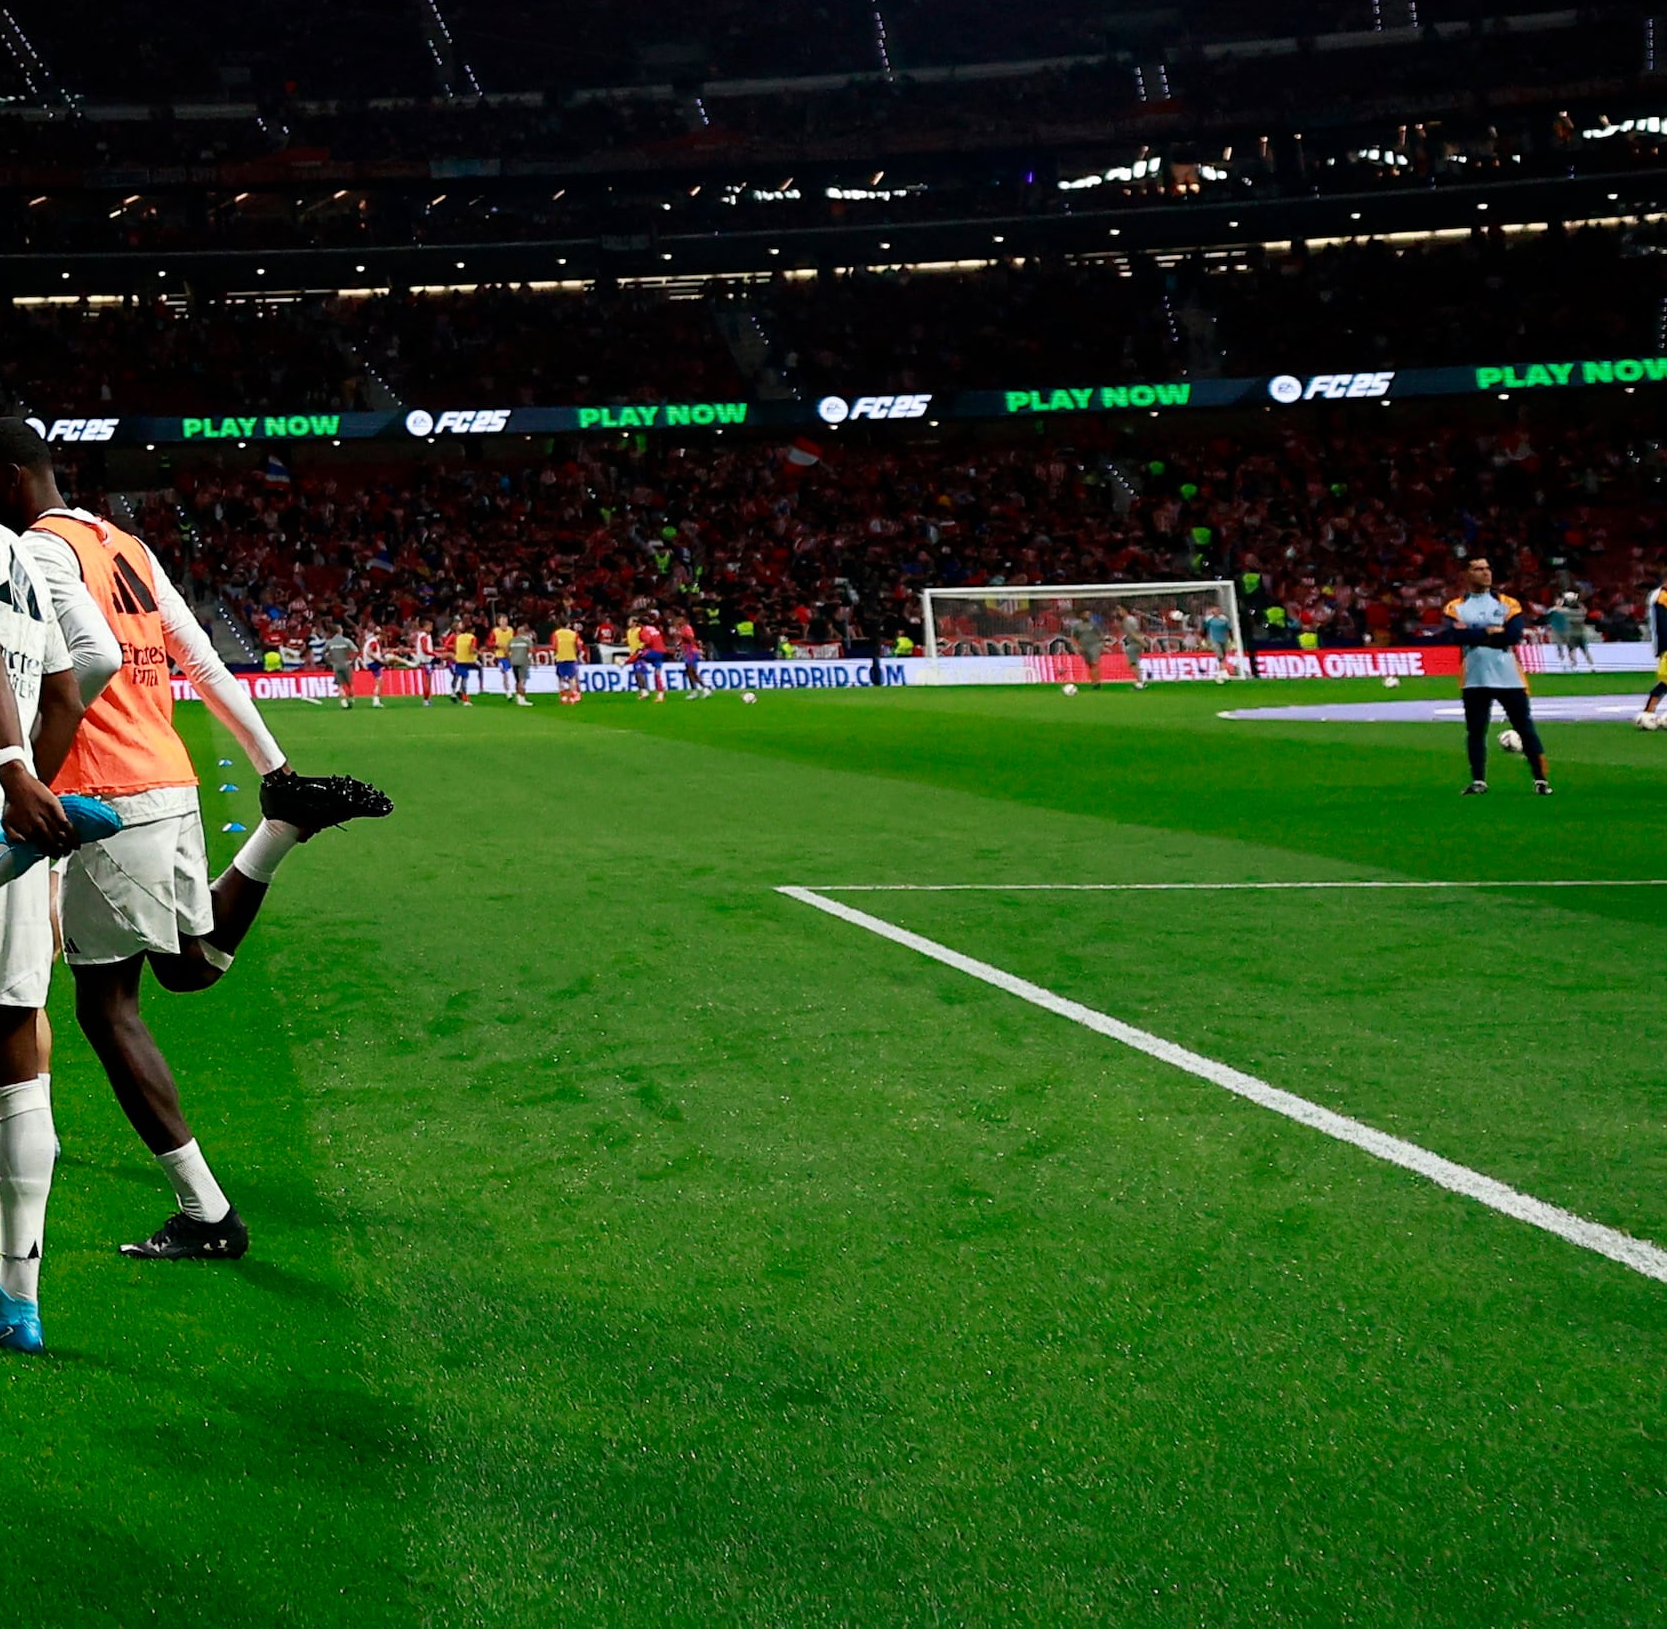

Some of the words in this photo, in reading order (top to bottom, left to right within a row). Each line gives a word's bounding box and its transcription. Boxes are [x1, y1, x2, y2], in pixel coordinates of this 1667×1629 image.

[1304, 371, 1396, 400] FC25
[1475, 362, 1574, 390] PLAY
[849, 394, 933, 420] FC25
[1005, 388, 1094, 413] PLAY
[1100, 383, 1191, 408] NOW
[182, 416, 258, 438] PLAY
[263, 415, 340, 437] NOW
[434, 409, 512, 435] FC25
[578, 405, 659, 429] PLAY
[665, 402, 748, 426] NOW
[46, 418, 120, 442] FC25
[1325, 652, 1425, 677] ONLINE
[255, 675, 341, 700] ONLINE
